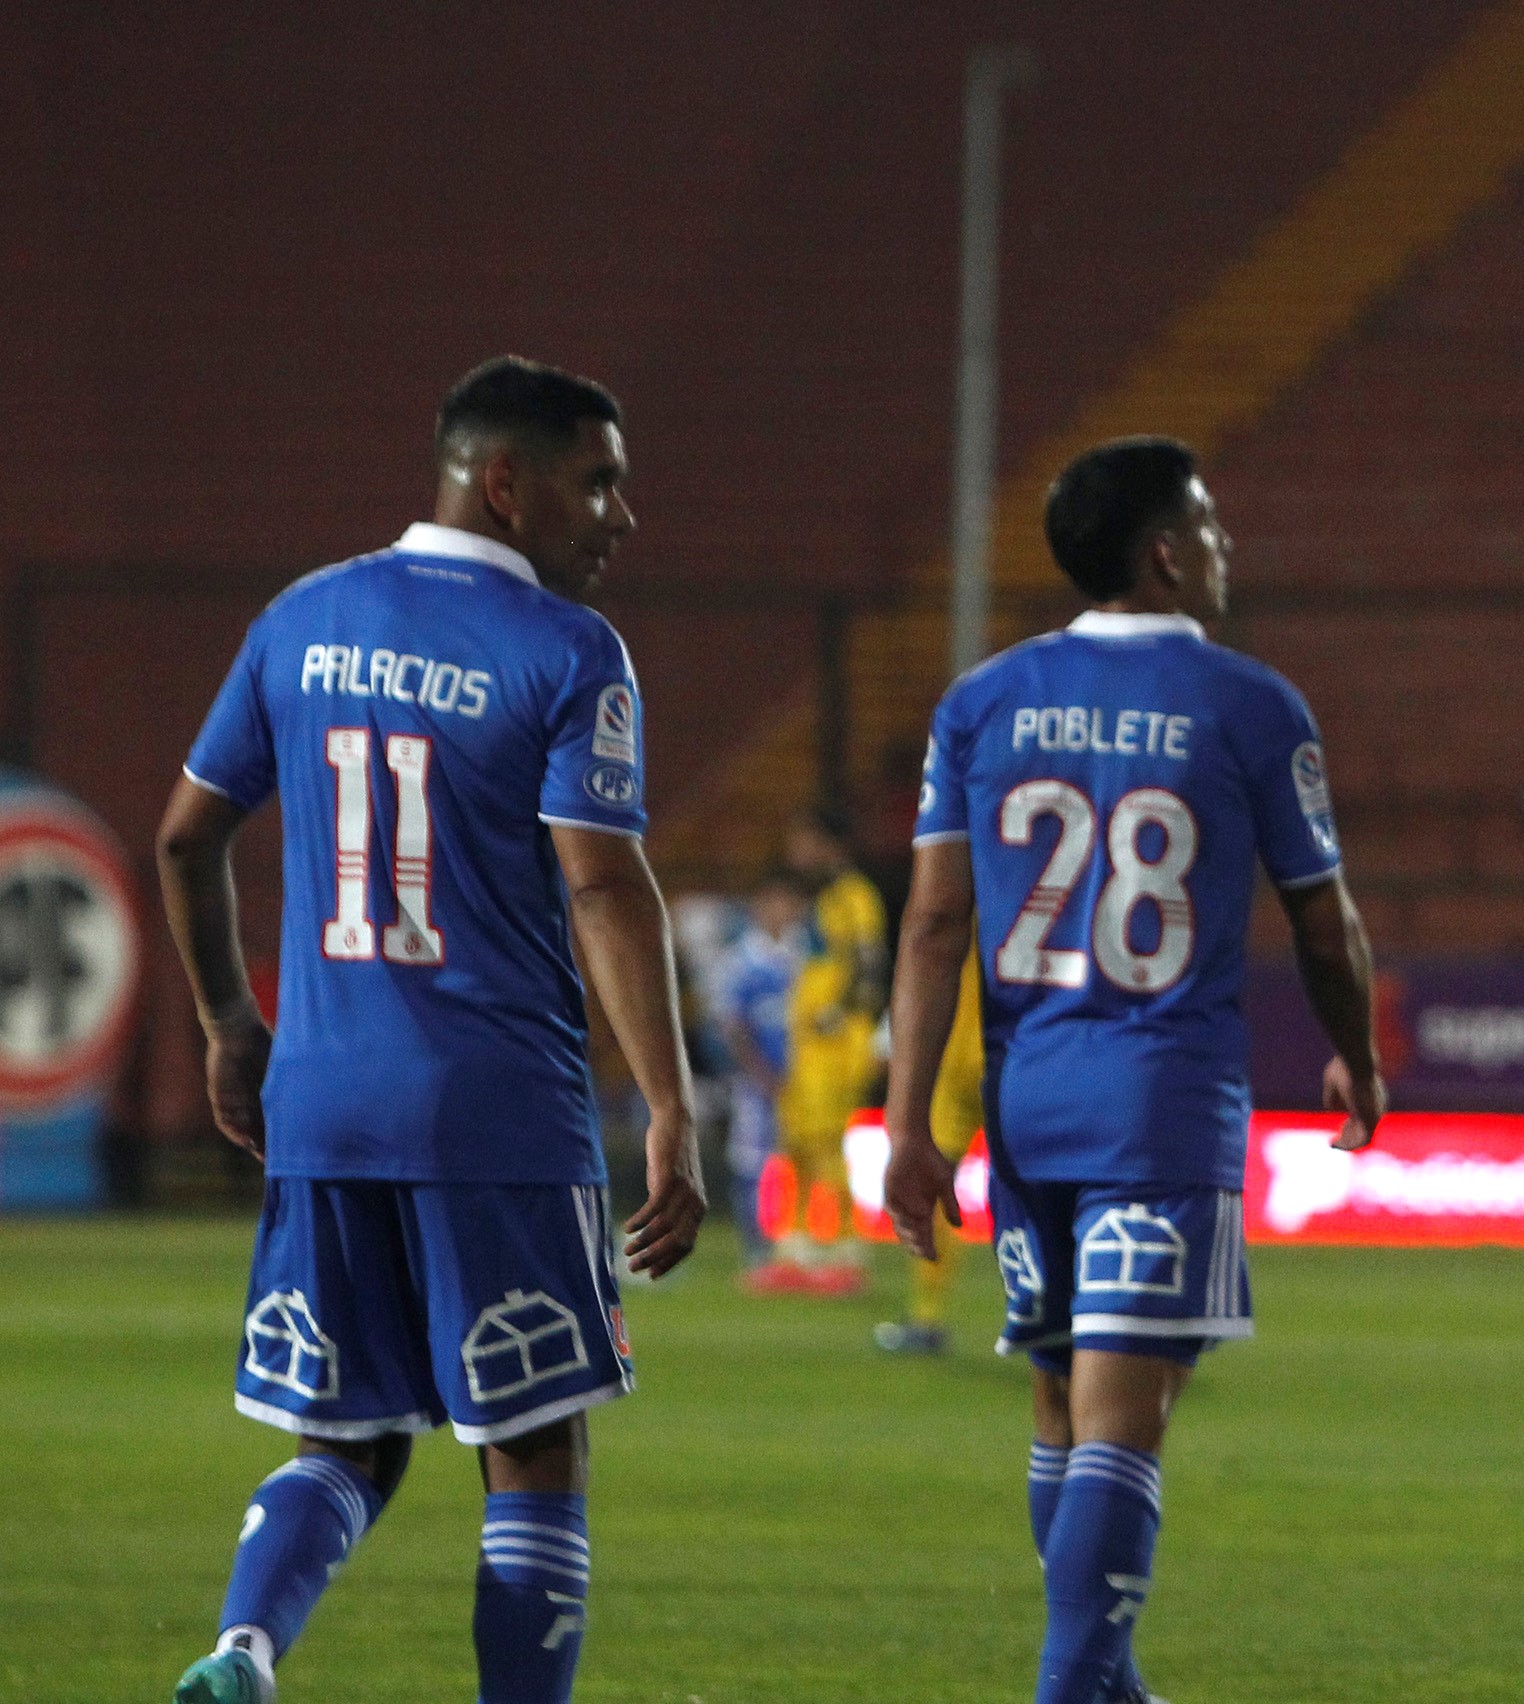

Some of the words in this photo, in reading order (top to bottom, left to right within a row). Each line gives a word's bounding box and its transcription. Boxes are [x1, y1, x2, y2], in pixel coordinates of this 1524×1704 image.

[301, 643, 491, 719] PALACIOS
[1012, 706, 1193, 760] POBLETE
[321, 727, 445, 967] 11
[996, 778, 1198, 993] 28
